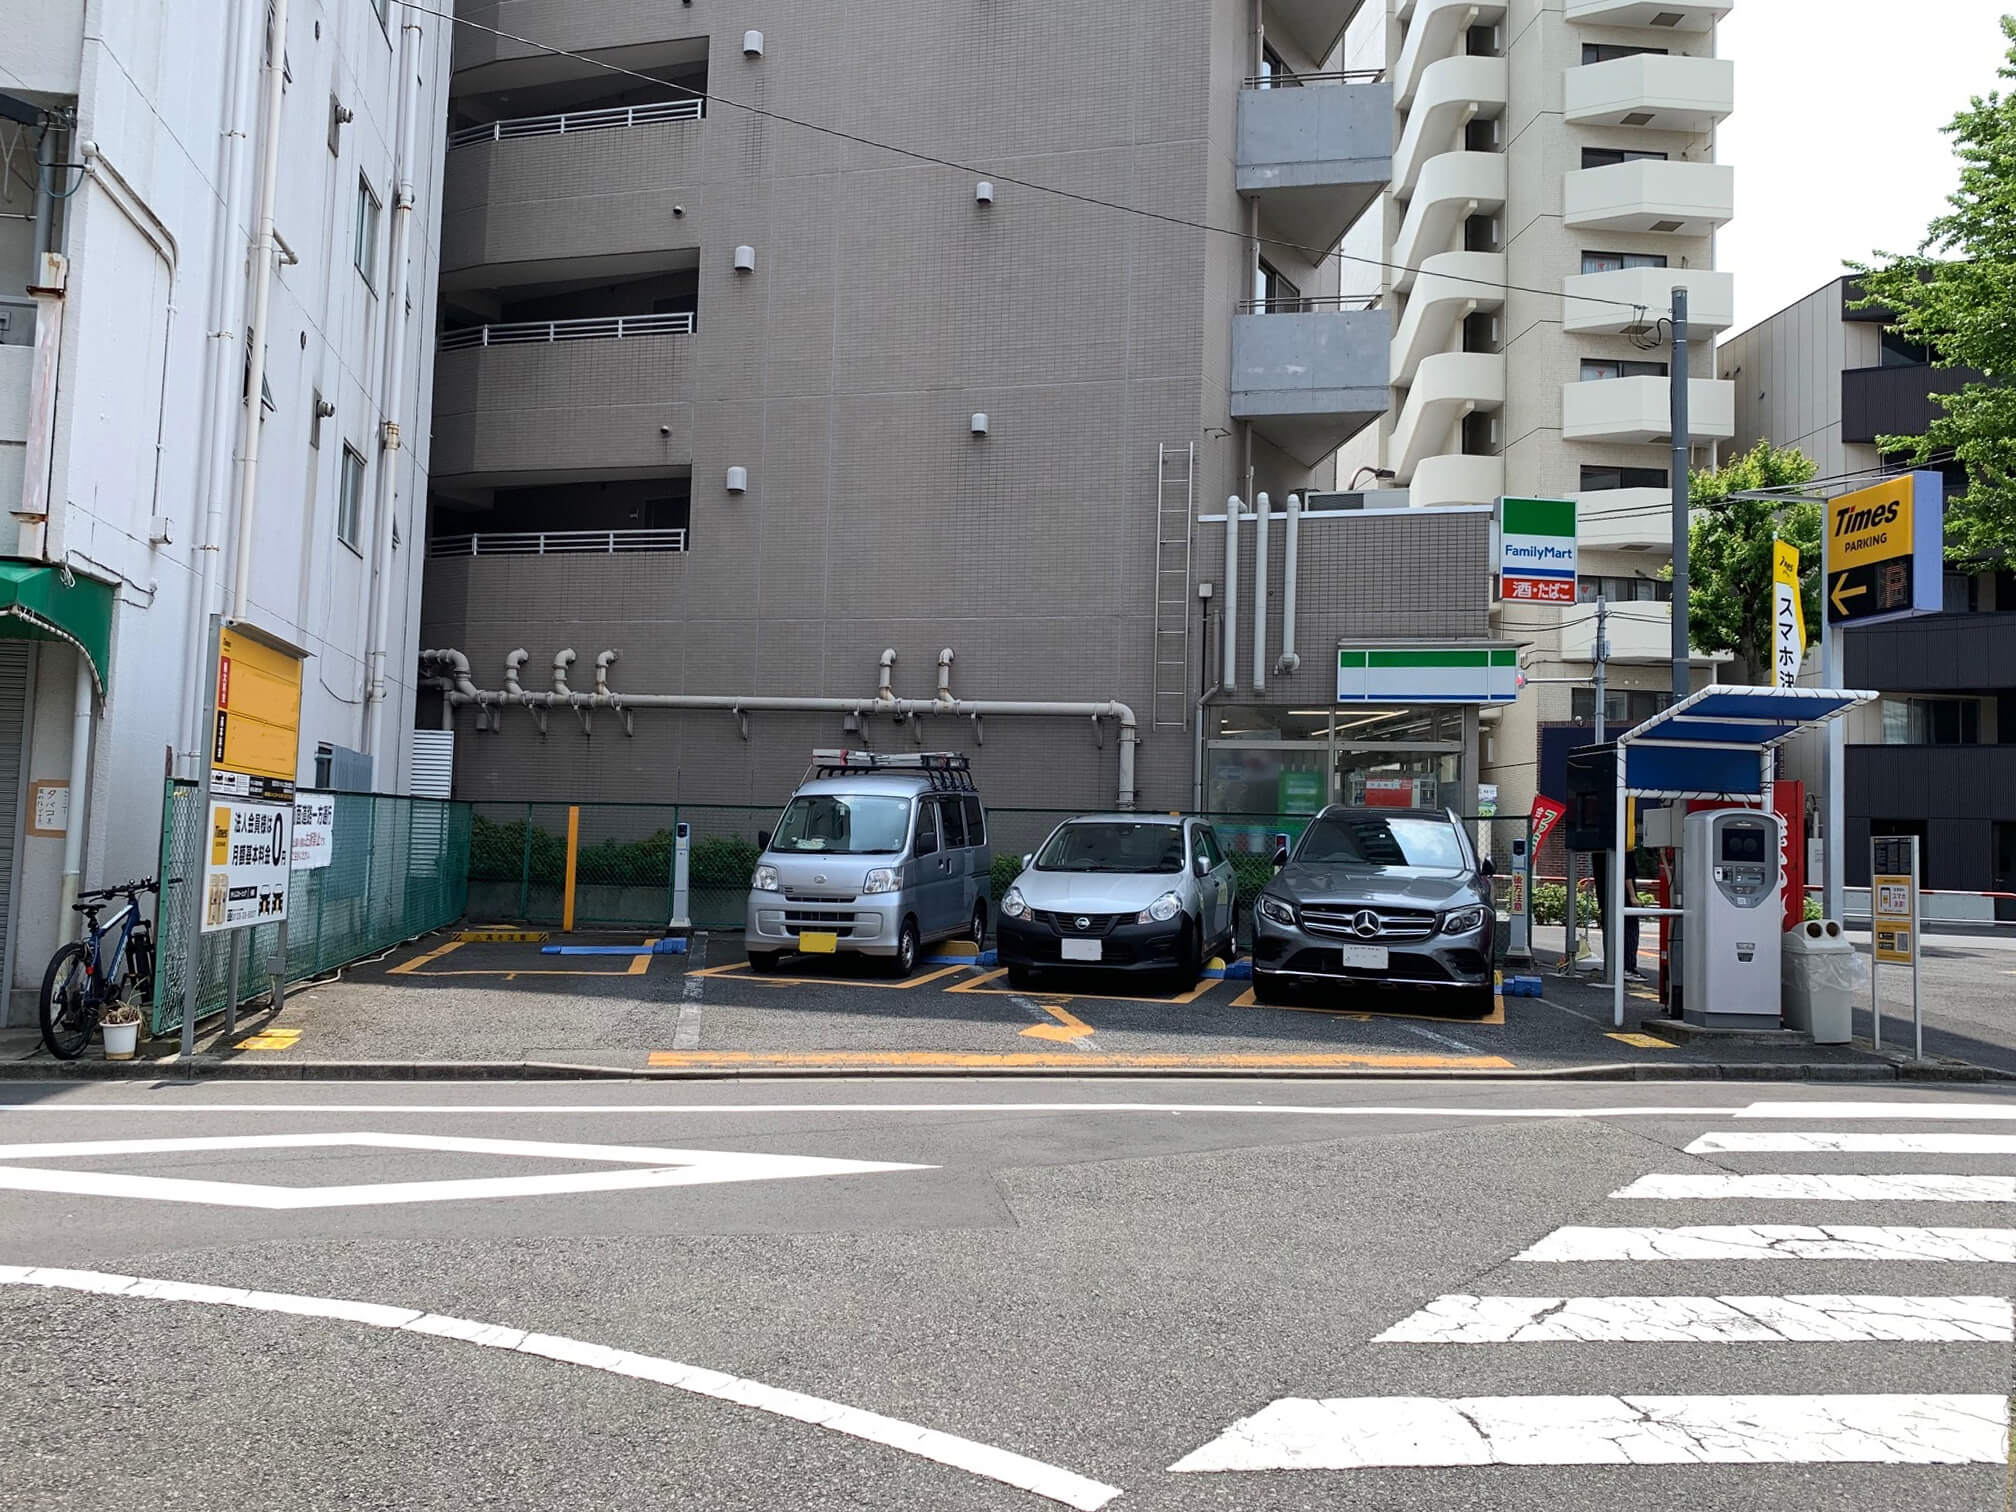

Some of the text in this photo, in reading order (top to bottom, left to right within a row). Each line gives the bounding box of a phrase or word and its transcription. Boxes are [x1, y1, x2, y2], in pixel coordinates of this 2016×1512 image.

[1834, 499, 1900, 537] Times
[1505, 544, 1573, 561] FamilyMart
[1844, 532, 1888, 553] PARKING
[1512, 581, 1570, 600] 酒・たばこ
